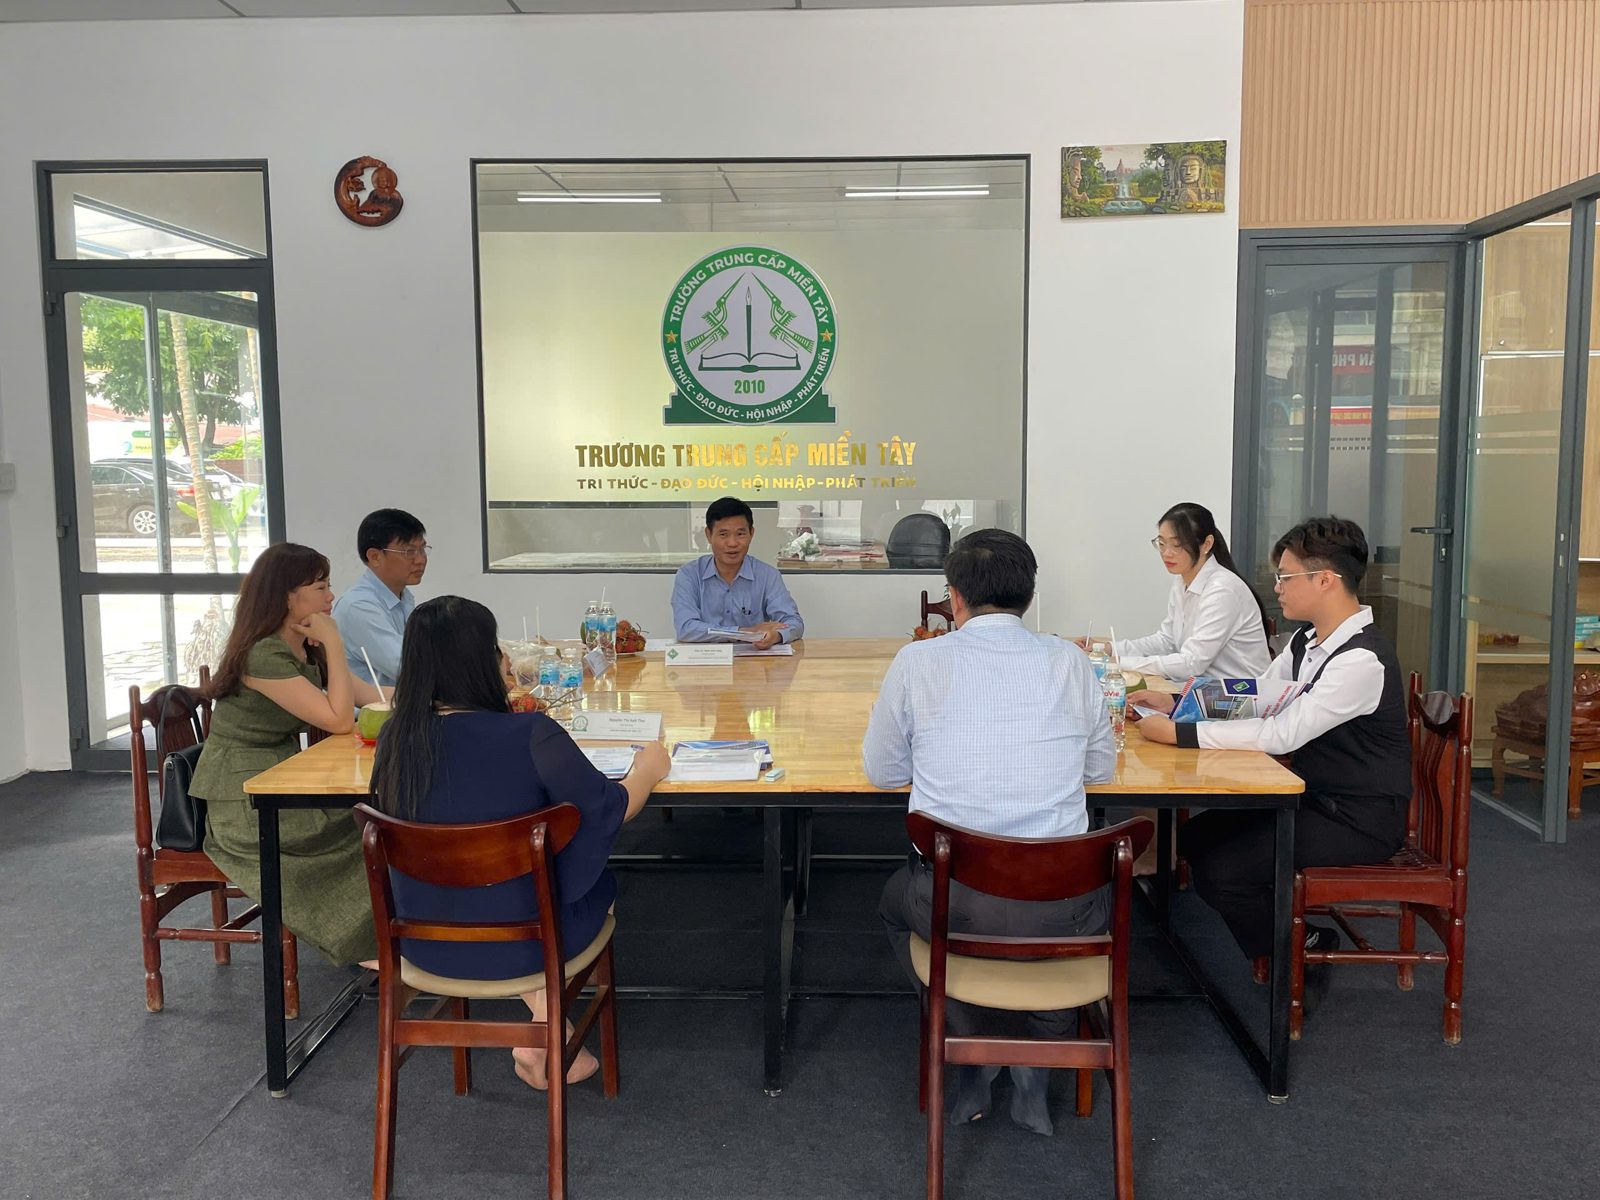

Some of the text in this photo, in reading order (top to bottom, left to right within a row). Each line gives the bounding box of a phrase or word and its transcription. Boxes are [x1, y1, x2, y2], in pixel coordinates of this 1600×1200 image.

[670, 253, 829, 324] TRƯỜNG TRUNG CẤP MIỀN TÂY
[669, 348, 679, 364] TRI
[674, 364, 695, 392] THỨC
[695, 392, 717, 409] ĐẠO
[716, 405, 740, 418] ĐỨC
[746, 408, 765, 421] HỘI
[766, 400, 793, 417] NHẬP
[796, 376, 818, 400] PHÁT
[734, 379, 765, 394] 2010
[672, 443, 747, 468] TRUNG
[754, 431, 799, 467] CẤP
[807, 430, 867, 467] MIỀN
[876, 435, 917, 466] TÂY
[577, 478, 602, 489] TRI
[607, 475, 649, 489] THỨC
[660, 478, 692, 492] ĐẠO
[696, 474, 728, 489] ĐỨC
[741, 474, 769, 492] HỘI
